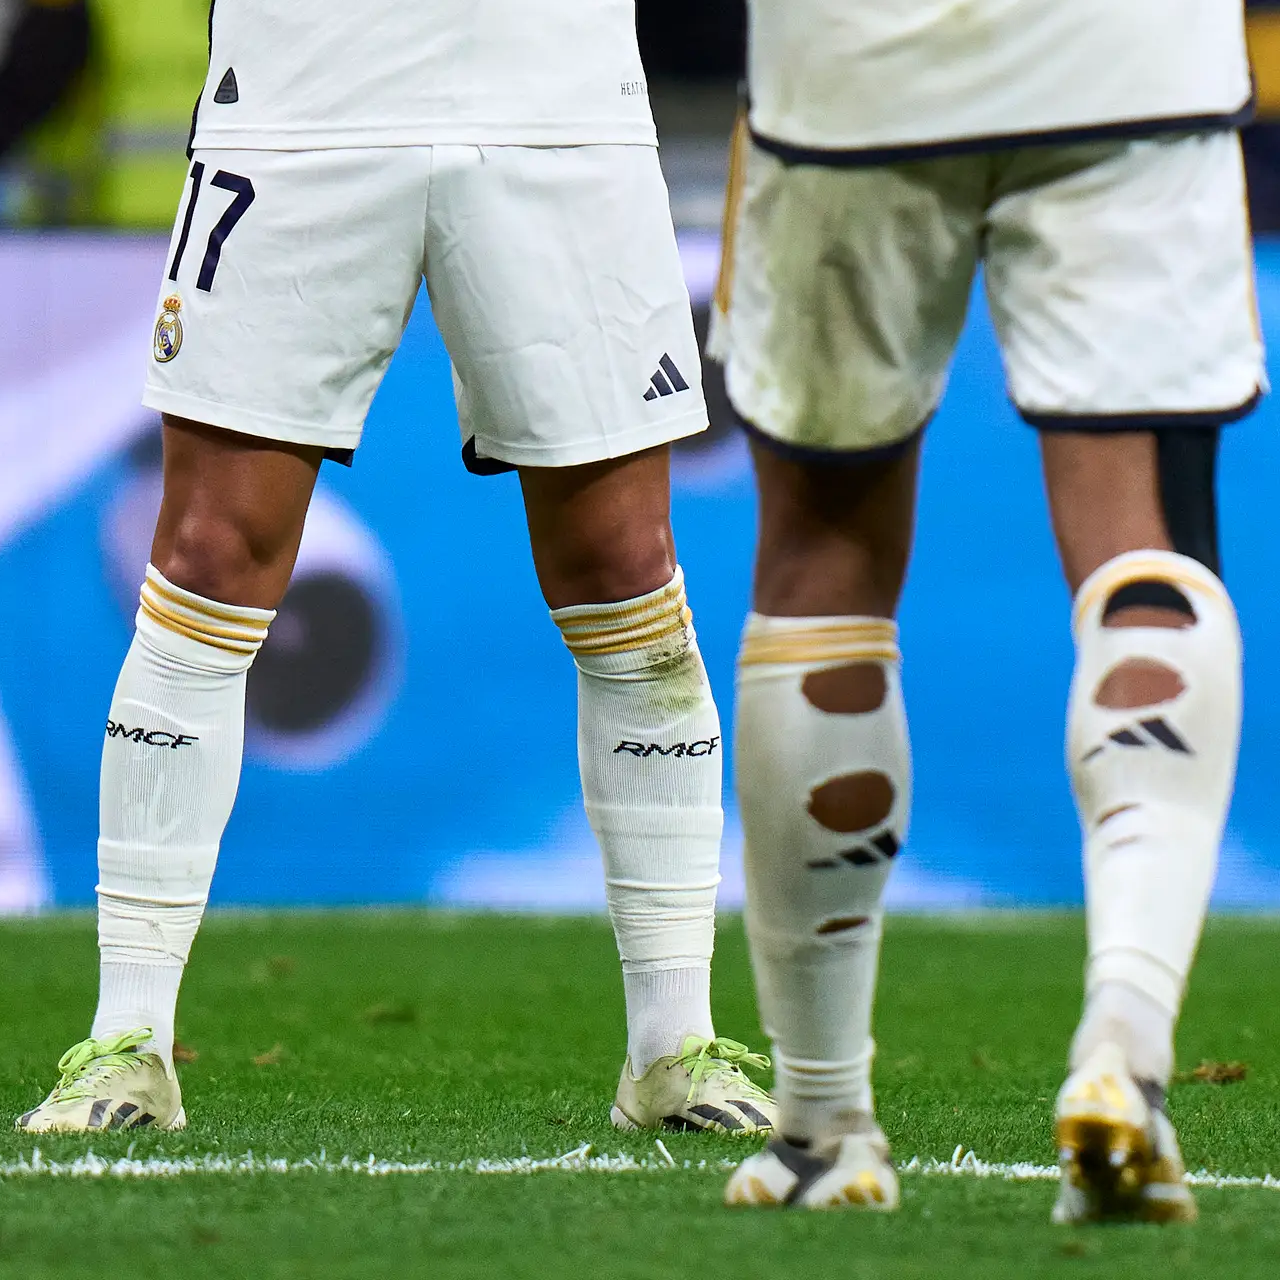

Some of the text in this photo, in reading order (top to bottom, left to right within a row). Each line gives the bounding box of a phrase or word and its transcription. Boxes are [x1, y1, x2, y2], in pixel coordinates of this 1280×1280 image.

[168, 160, 256, 293] 17
[106, 718, 199, 749] RMCF
[613, 735, 720, 758] RMCF
